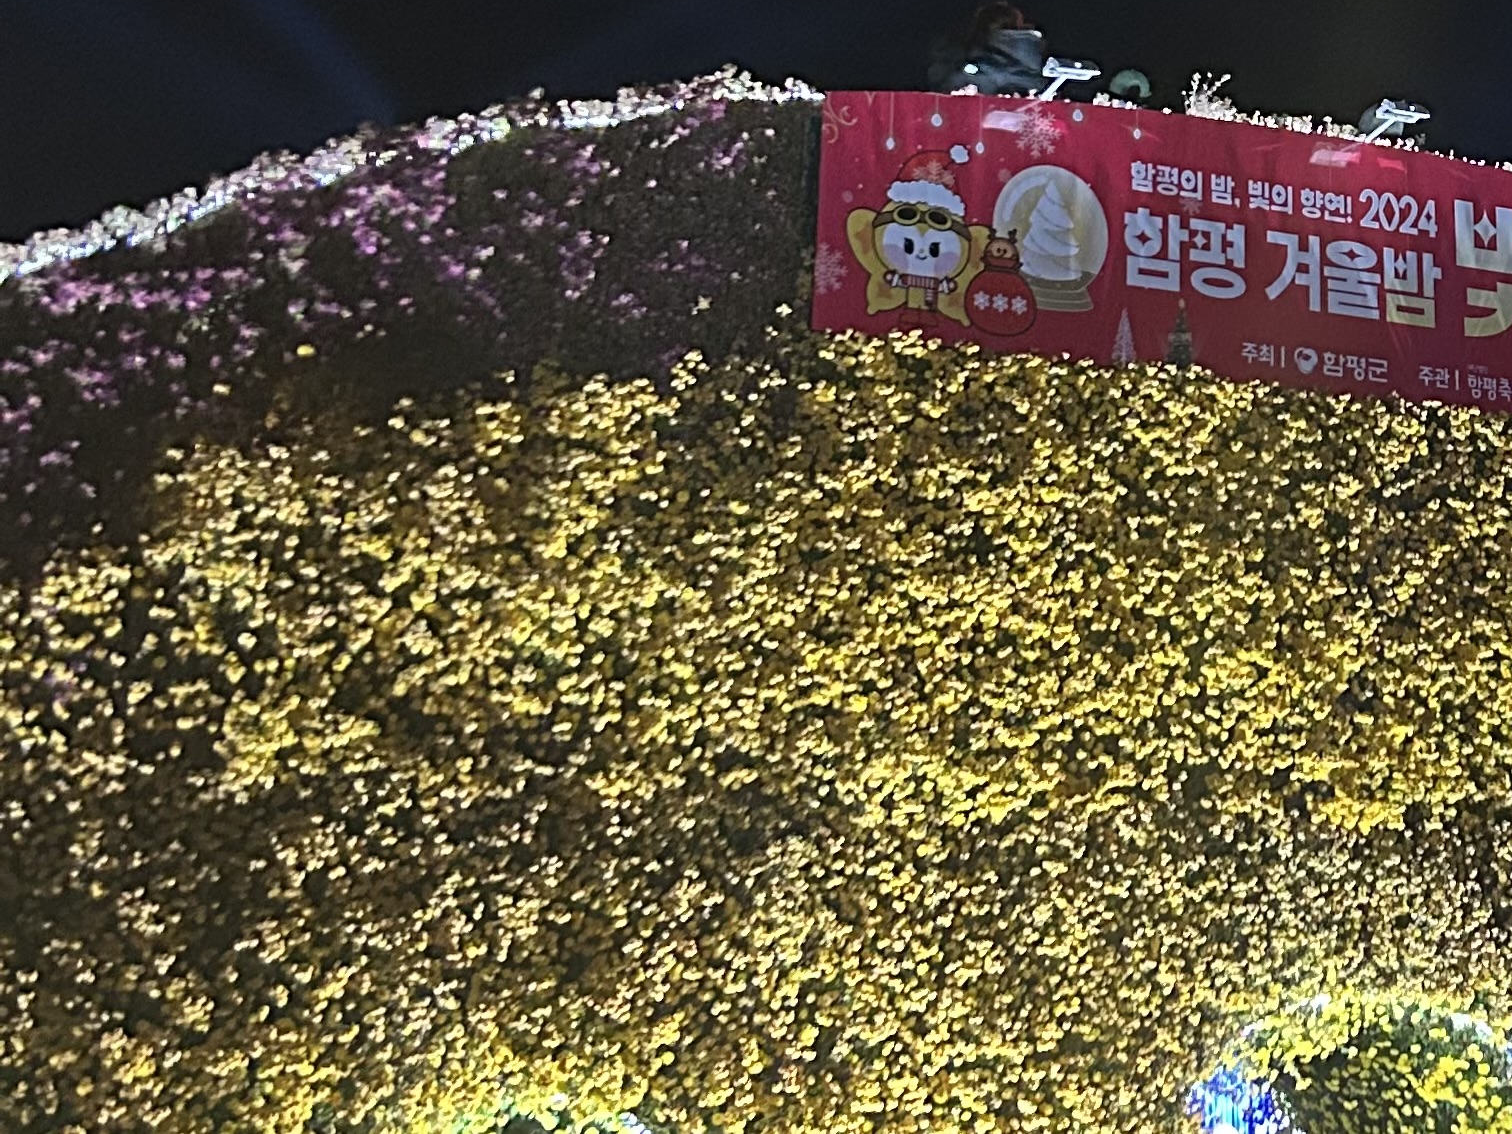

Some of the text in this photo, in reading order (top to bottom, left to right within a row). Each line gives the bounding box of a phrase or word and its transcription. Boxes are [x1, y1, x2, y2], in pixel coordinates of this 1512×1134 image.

[1130, 160, 1437, 238] 함평의 밤, 빛의 향연! 2024
[1124, 207, 1246, 299] 함평
[1265, 230, 1442, 328] 겨울밤
[1241, 342, 1388, 383] 주최 함평군
[1418, 365, 1450, 389] 주관
